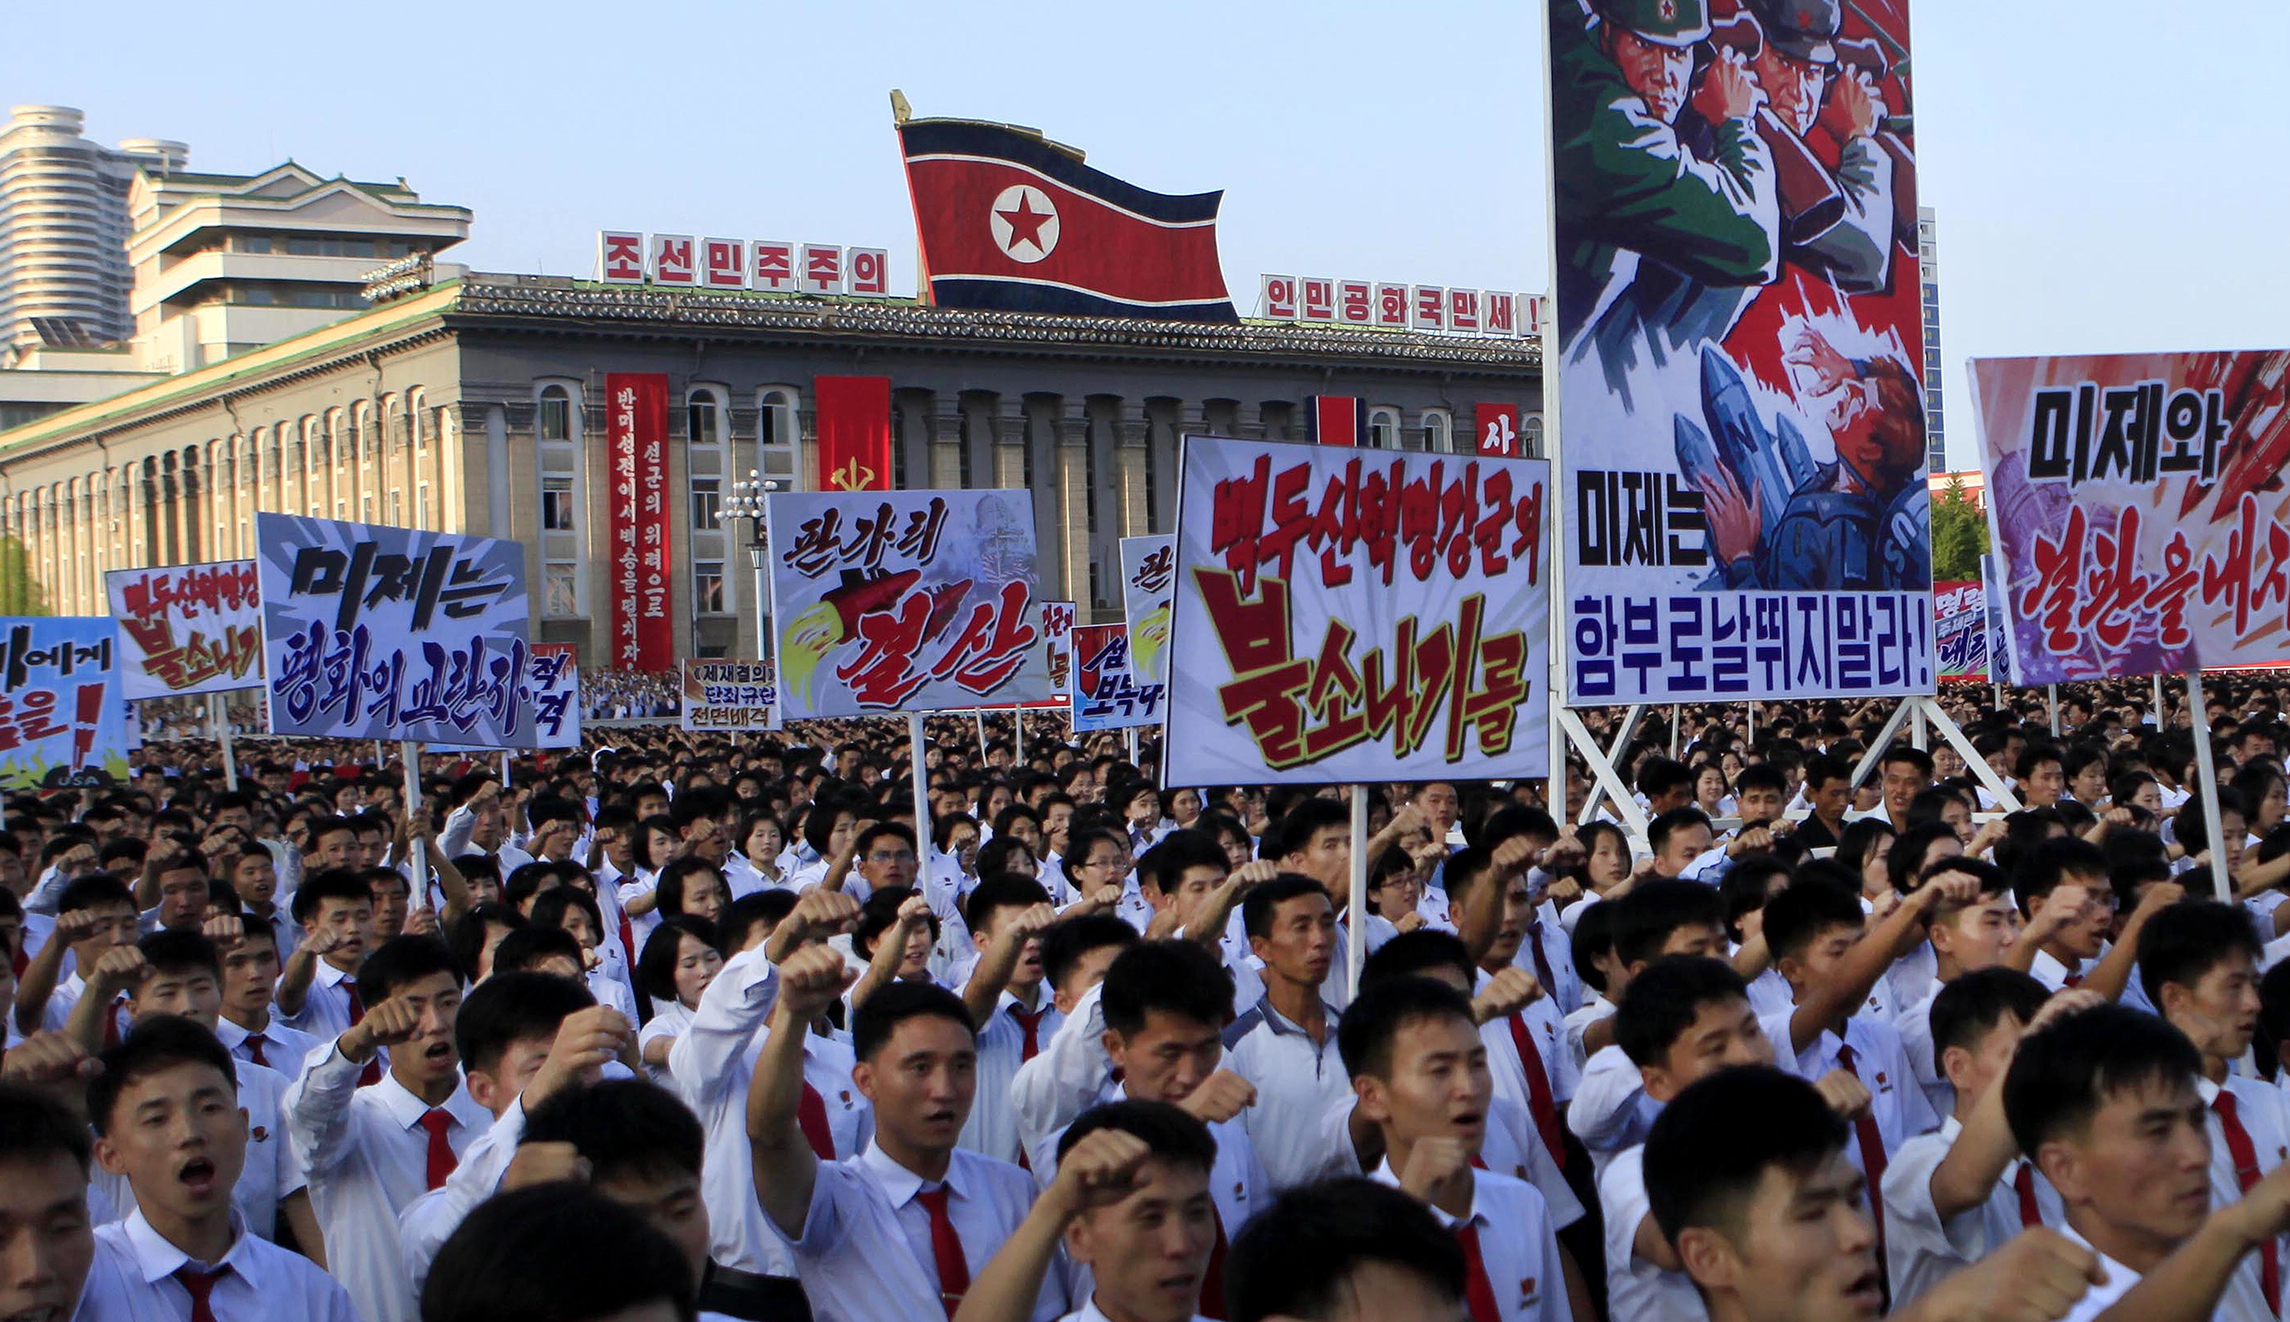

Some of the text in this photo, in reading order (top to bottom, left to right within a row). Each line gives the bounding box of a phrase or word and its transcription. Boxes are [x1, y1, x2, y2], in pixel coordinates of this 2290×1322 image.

[607, 236, 885, 293] 조선민주주의
[2029, 384, 2229, 488] 미제와
[783, 497, 947, 578] 판가리
[1577, 470, 1707, 566] 미제는
[289, 541, 508, 632] 미제는
[1191, 566, 1530, 771] 불소나기를
[690, 707, 769, 727] 전면배격
[58, 775, 100, 787] USA
